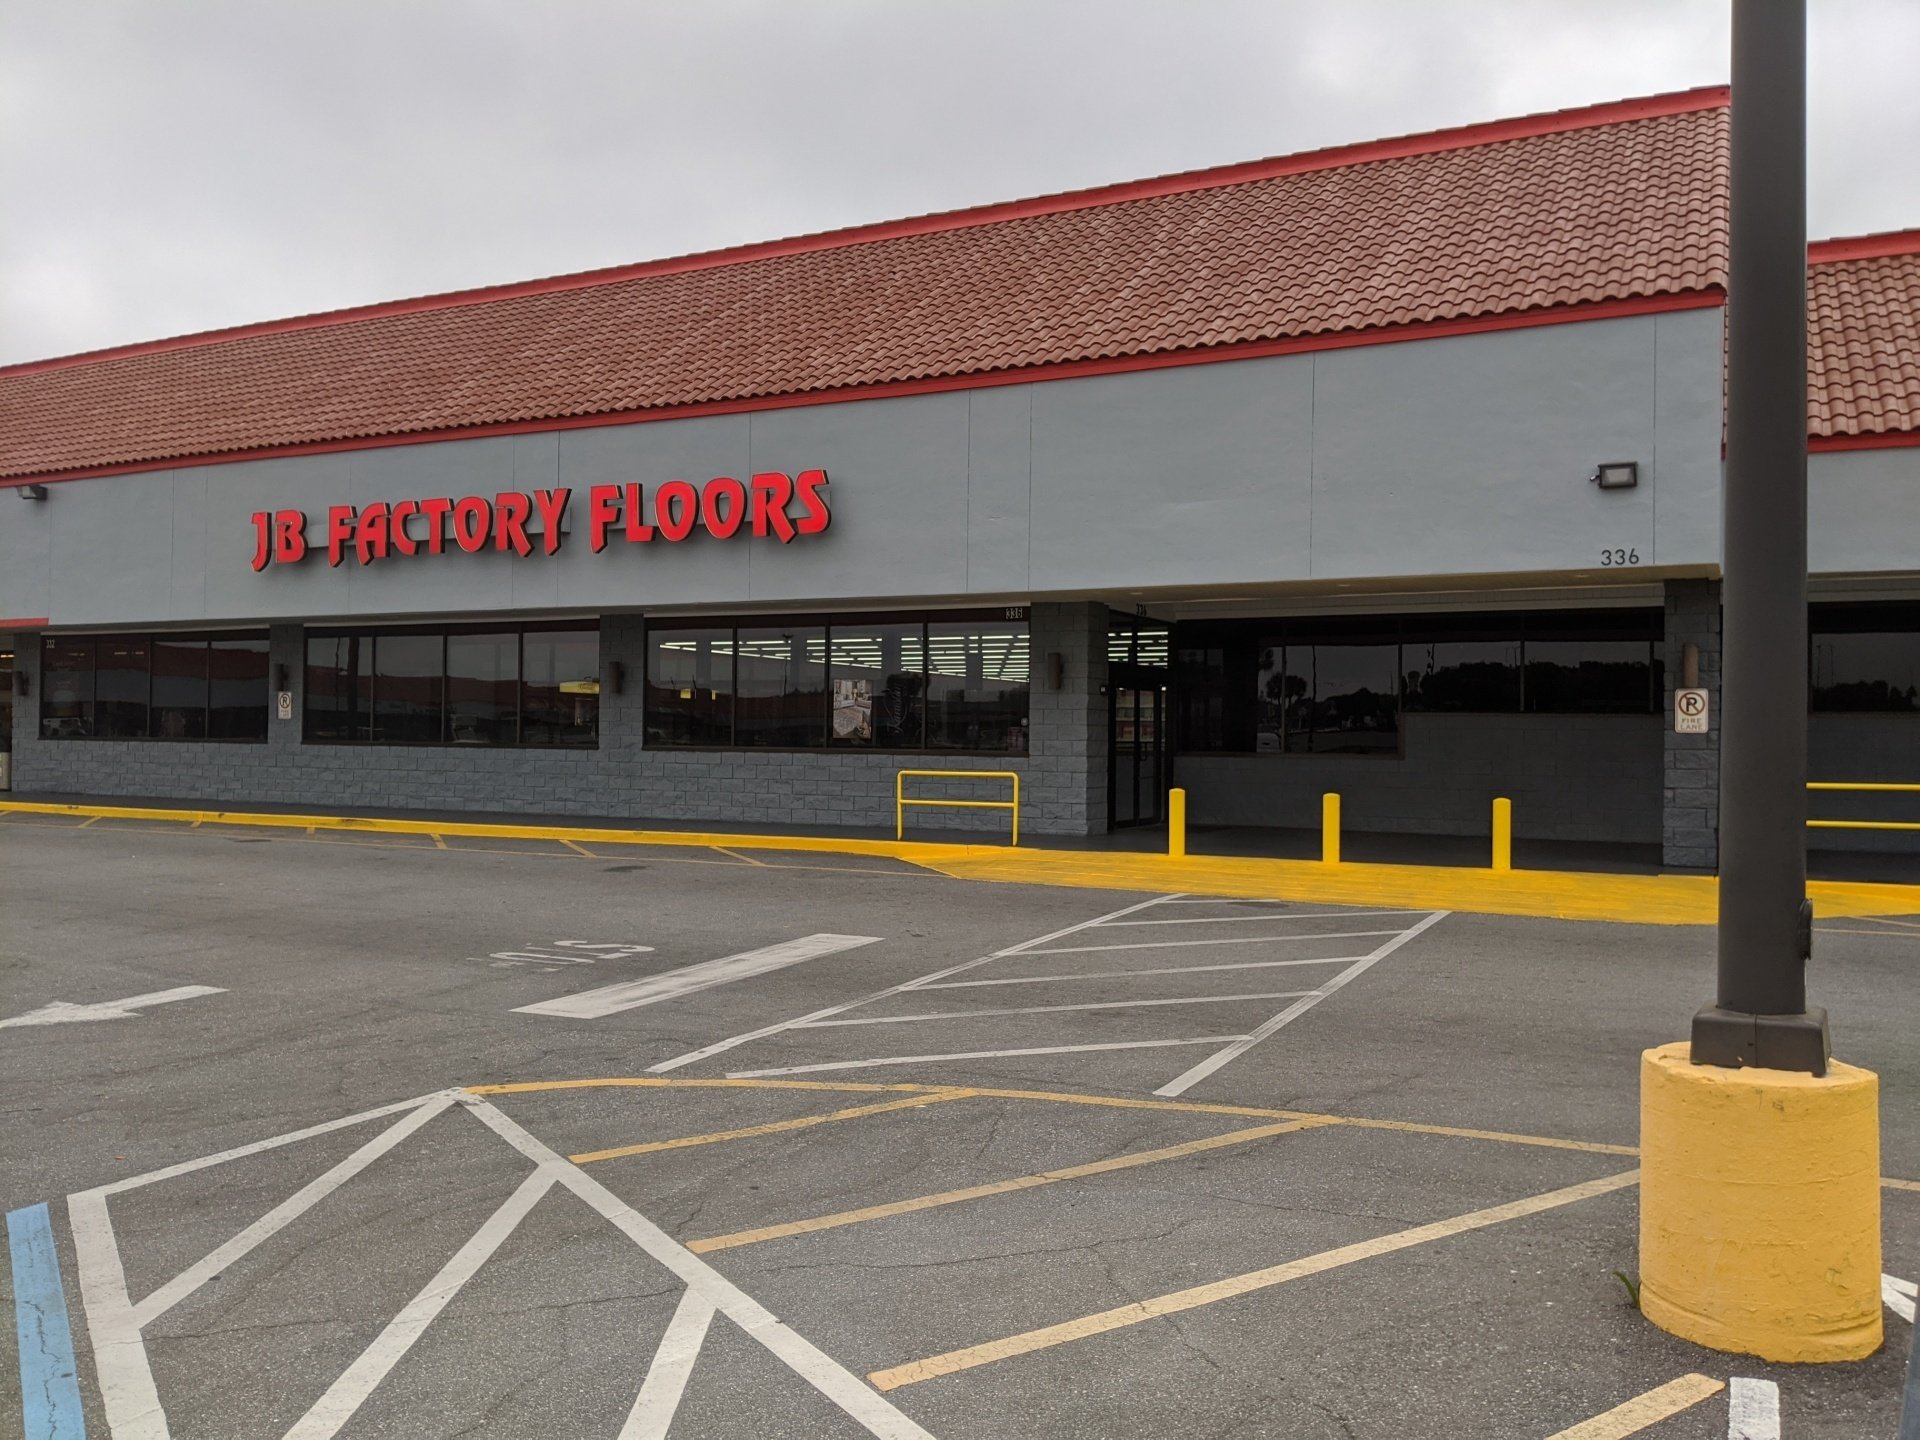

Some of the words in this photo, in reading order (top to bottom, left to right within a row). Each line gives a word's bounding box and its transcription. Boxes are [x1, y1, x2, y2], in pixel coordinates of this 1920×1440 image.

[251, 509, 306, 572] JB
[328, 488, 572, 568] FACTORY
[590, 469, 829, 554] FLOORS
[1601, 548, 1639, 566] 336
